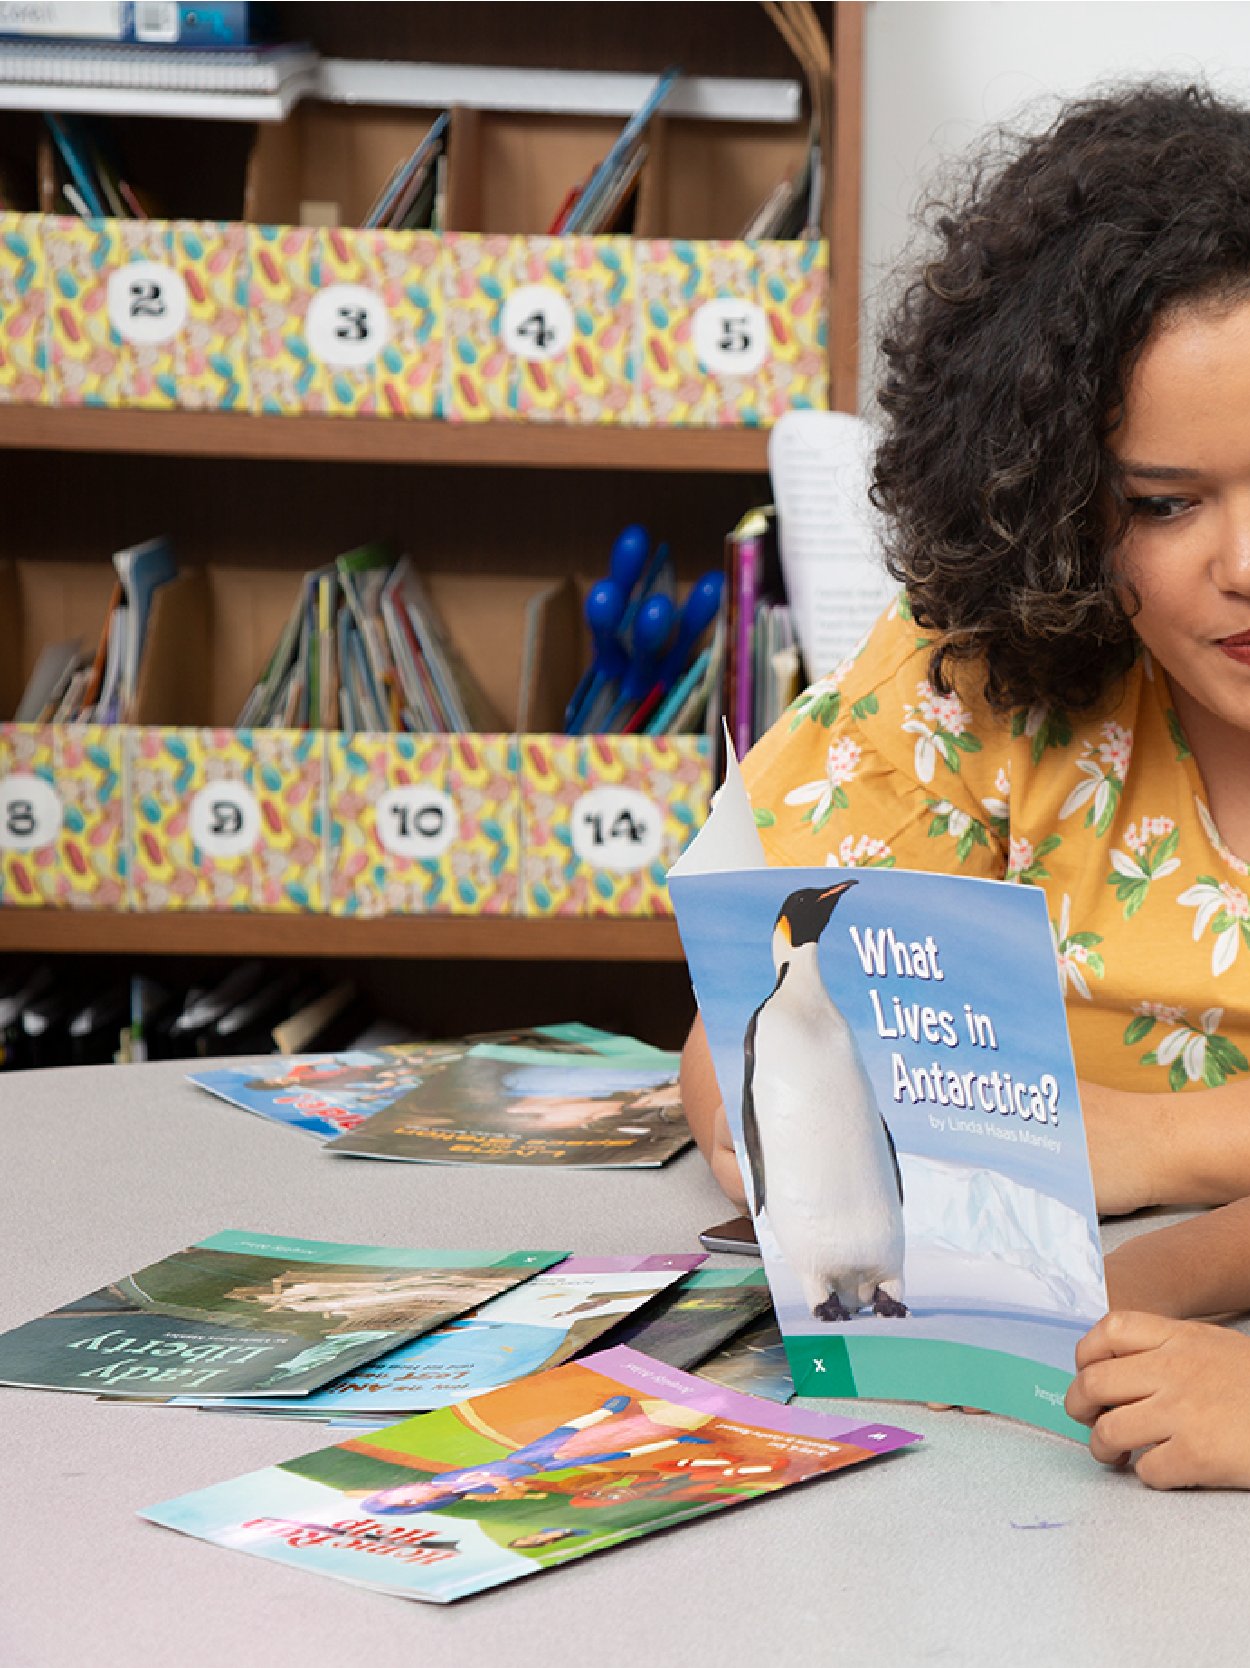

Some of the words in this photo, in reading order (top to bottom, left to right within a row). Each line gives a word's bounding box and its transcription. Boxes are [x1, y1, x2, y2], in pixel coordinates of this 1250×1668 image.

[129, 279, 167, 319] 2
[335, 307, 370, 342] 3
[516, 310, 556, 349] 4
[717, 314, 752, 353] 5
[5, 800, 39, 837] 8
[209, 800, 245, 835] 9
[390, 803, 445, 839] 10
[582, 807, 648, 847] 14
[849, 924, 945, 981] What
[868, 988, 960, 1049] Lives
[963, 1003, 999, 1051] in
[891, 1052, 1060, 1127] Antarctica?
[928, 1113, 945, 1132] by
[947, 1116, 983, 1138] Linda
[985, 1121, 1019, 1143] Haas
[1019, 1128, 1063, 1154] Manley
[66, 1329, 276, 1364] Liberty
[811, 1357, 828, 1374] X
[77, 1358, 229, 1388] Lady
